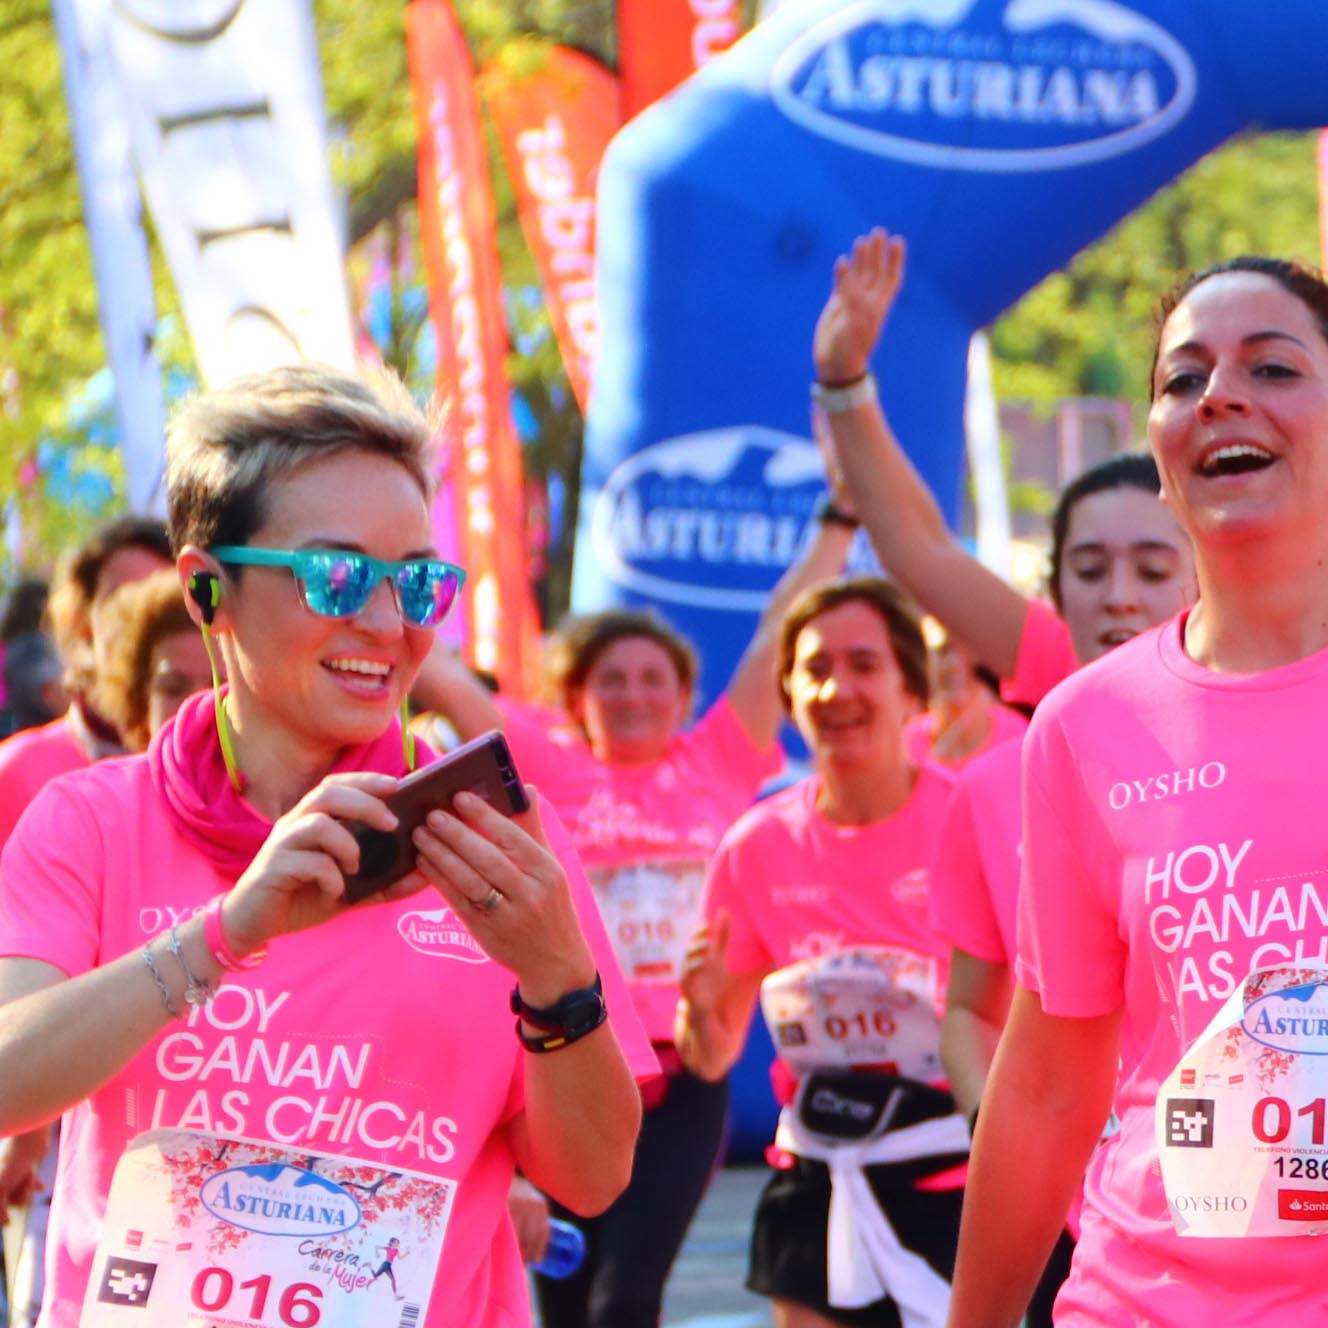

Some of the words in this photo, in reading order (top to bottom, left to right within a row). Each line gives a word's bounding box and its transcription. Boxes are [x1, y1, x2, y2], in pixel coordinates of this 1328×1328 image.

[801, 36, 1160, 124] ASTURIANA
[1108, 761, 1226, 809] OYSHO
[1145, 839, 1253, 904] HOY
[825, 1010, 897, 1040] 016
[156, 1031, 370, 1090] GANAN
[264, 1094, 458, 1164] CHICAS
[211, 1181, 347, 1228] ASTURIANA
[1175, 1195, 1247, 1212] OYSHO
[298, 1239, 360, 1267] Carrera
[328, 1264, 377, 1293] Mujer
